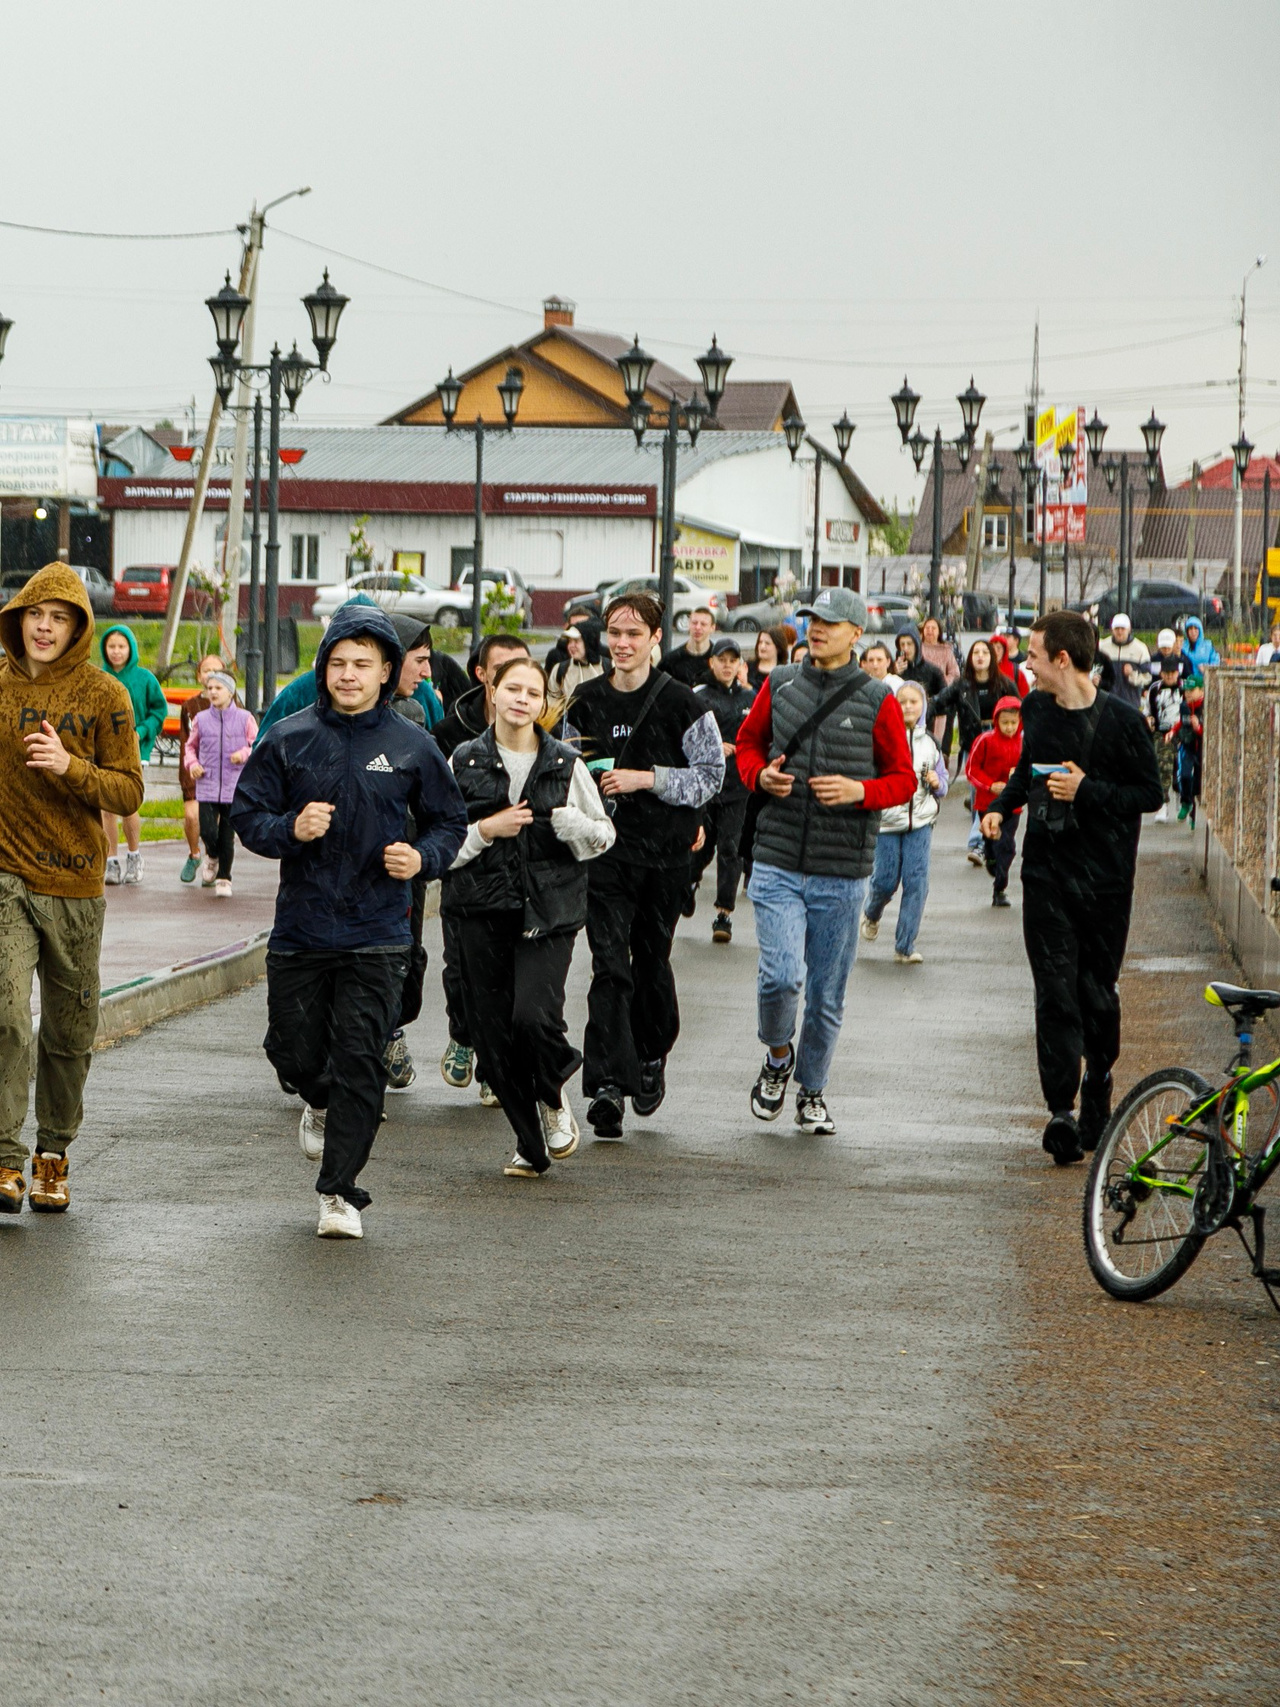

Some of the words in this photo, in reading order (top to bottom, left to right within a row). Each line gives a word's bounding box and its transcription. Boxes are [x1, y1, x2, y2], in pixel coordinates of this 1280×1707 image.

[124, 486, 173, 497] ЗАПЧАСТИ
[671, 545, 728, 557] АПРАВКА
[674, 558, 715, 571] АВТО
[365, 764, 394, 773] adidas
[35, 850, 97, 871] ENJOY
